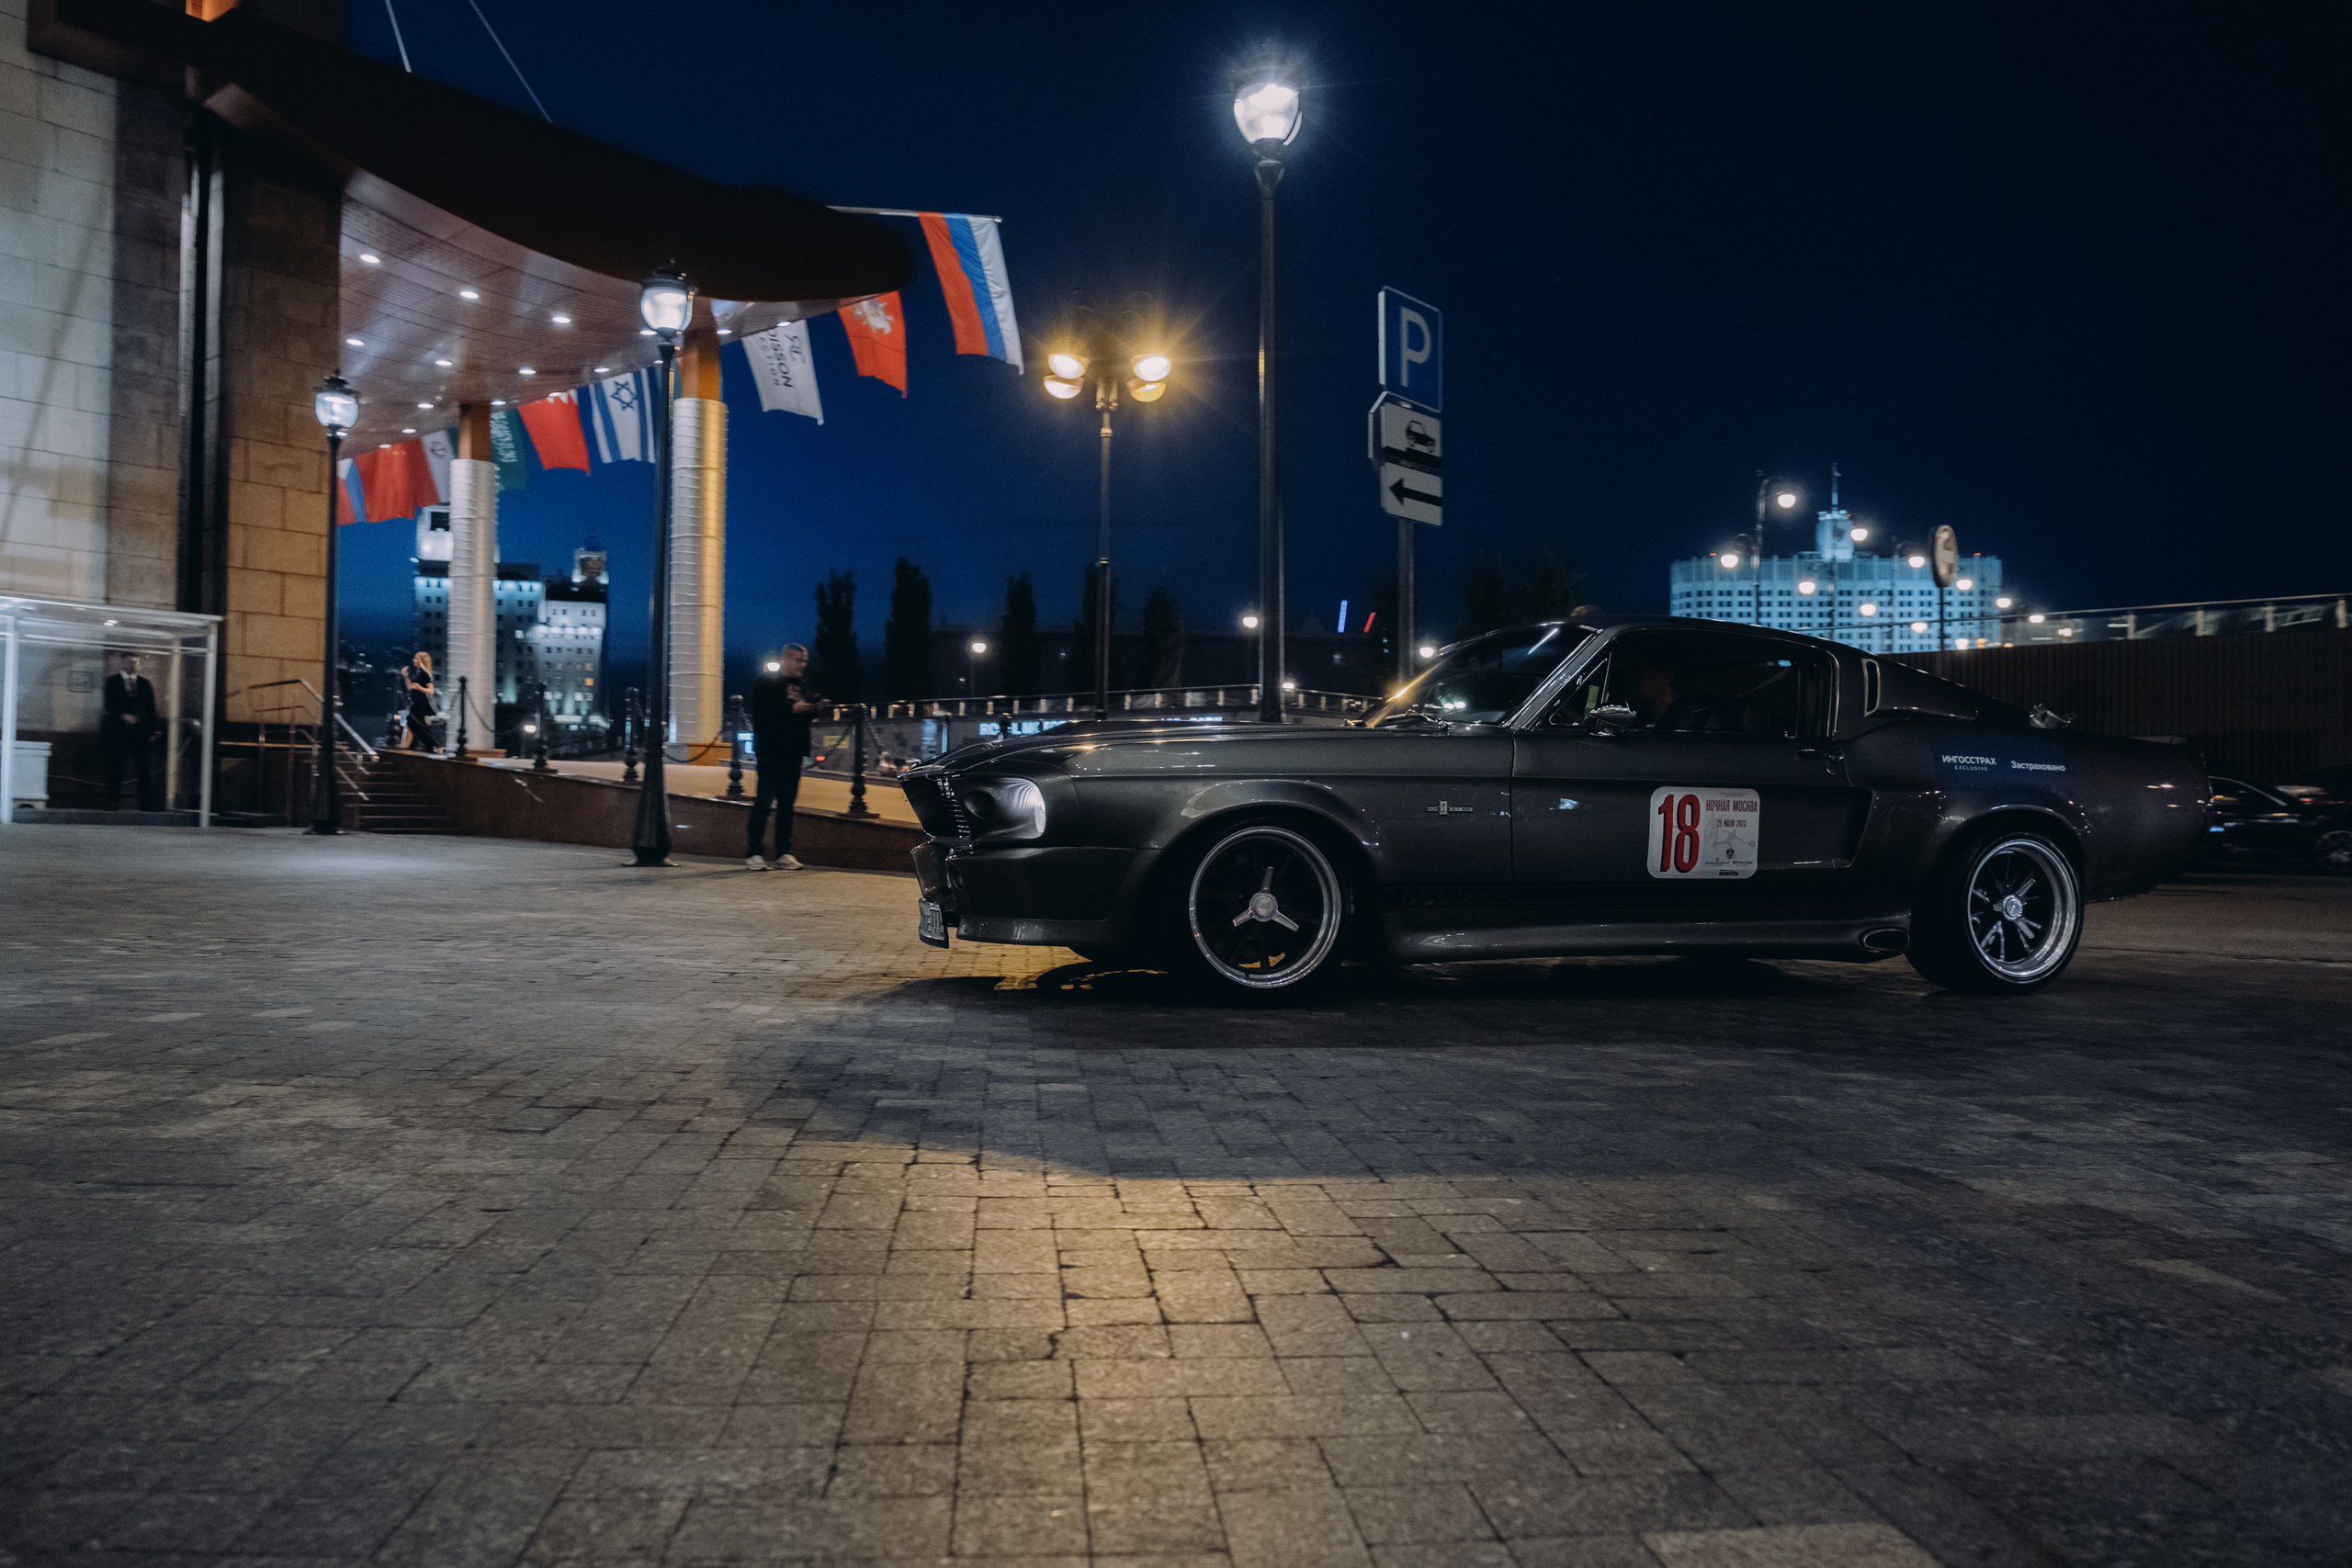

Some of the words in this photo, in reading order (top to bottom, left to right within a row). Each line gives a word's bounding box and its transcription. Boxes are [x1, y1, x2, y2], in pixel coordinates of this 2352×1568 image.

[1400, 306, 1432, 387] P
[1941, 755, 1996, 765] ИНГОССТРАХ
[2010, 761, 2066, 772] Застраховано
[1706, 799, 1731, 812] НОЧНАЯ
[1733, 800, 1758, 813] МОСКВА
[1716, 819, 1723, 828] 29
[1658, 794, 1701, 874] 18
